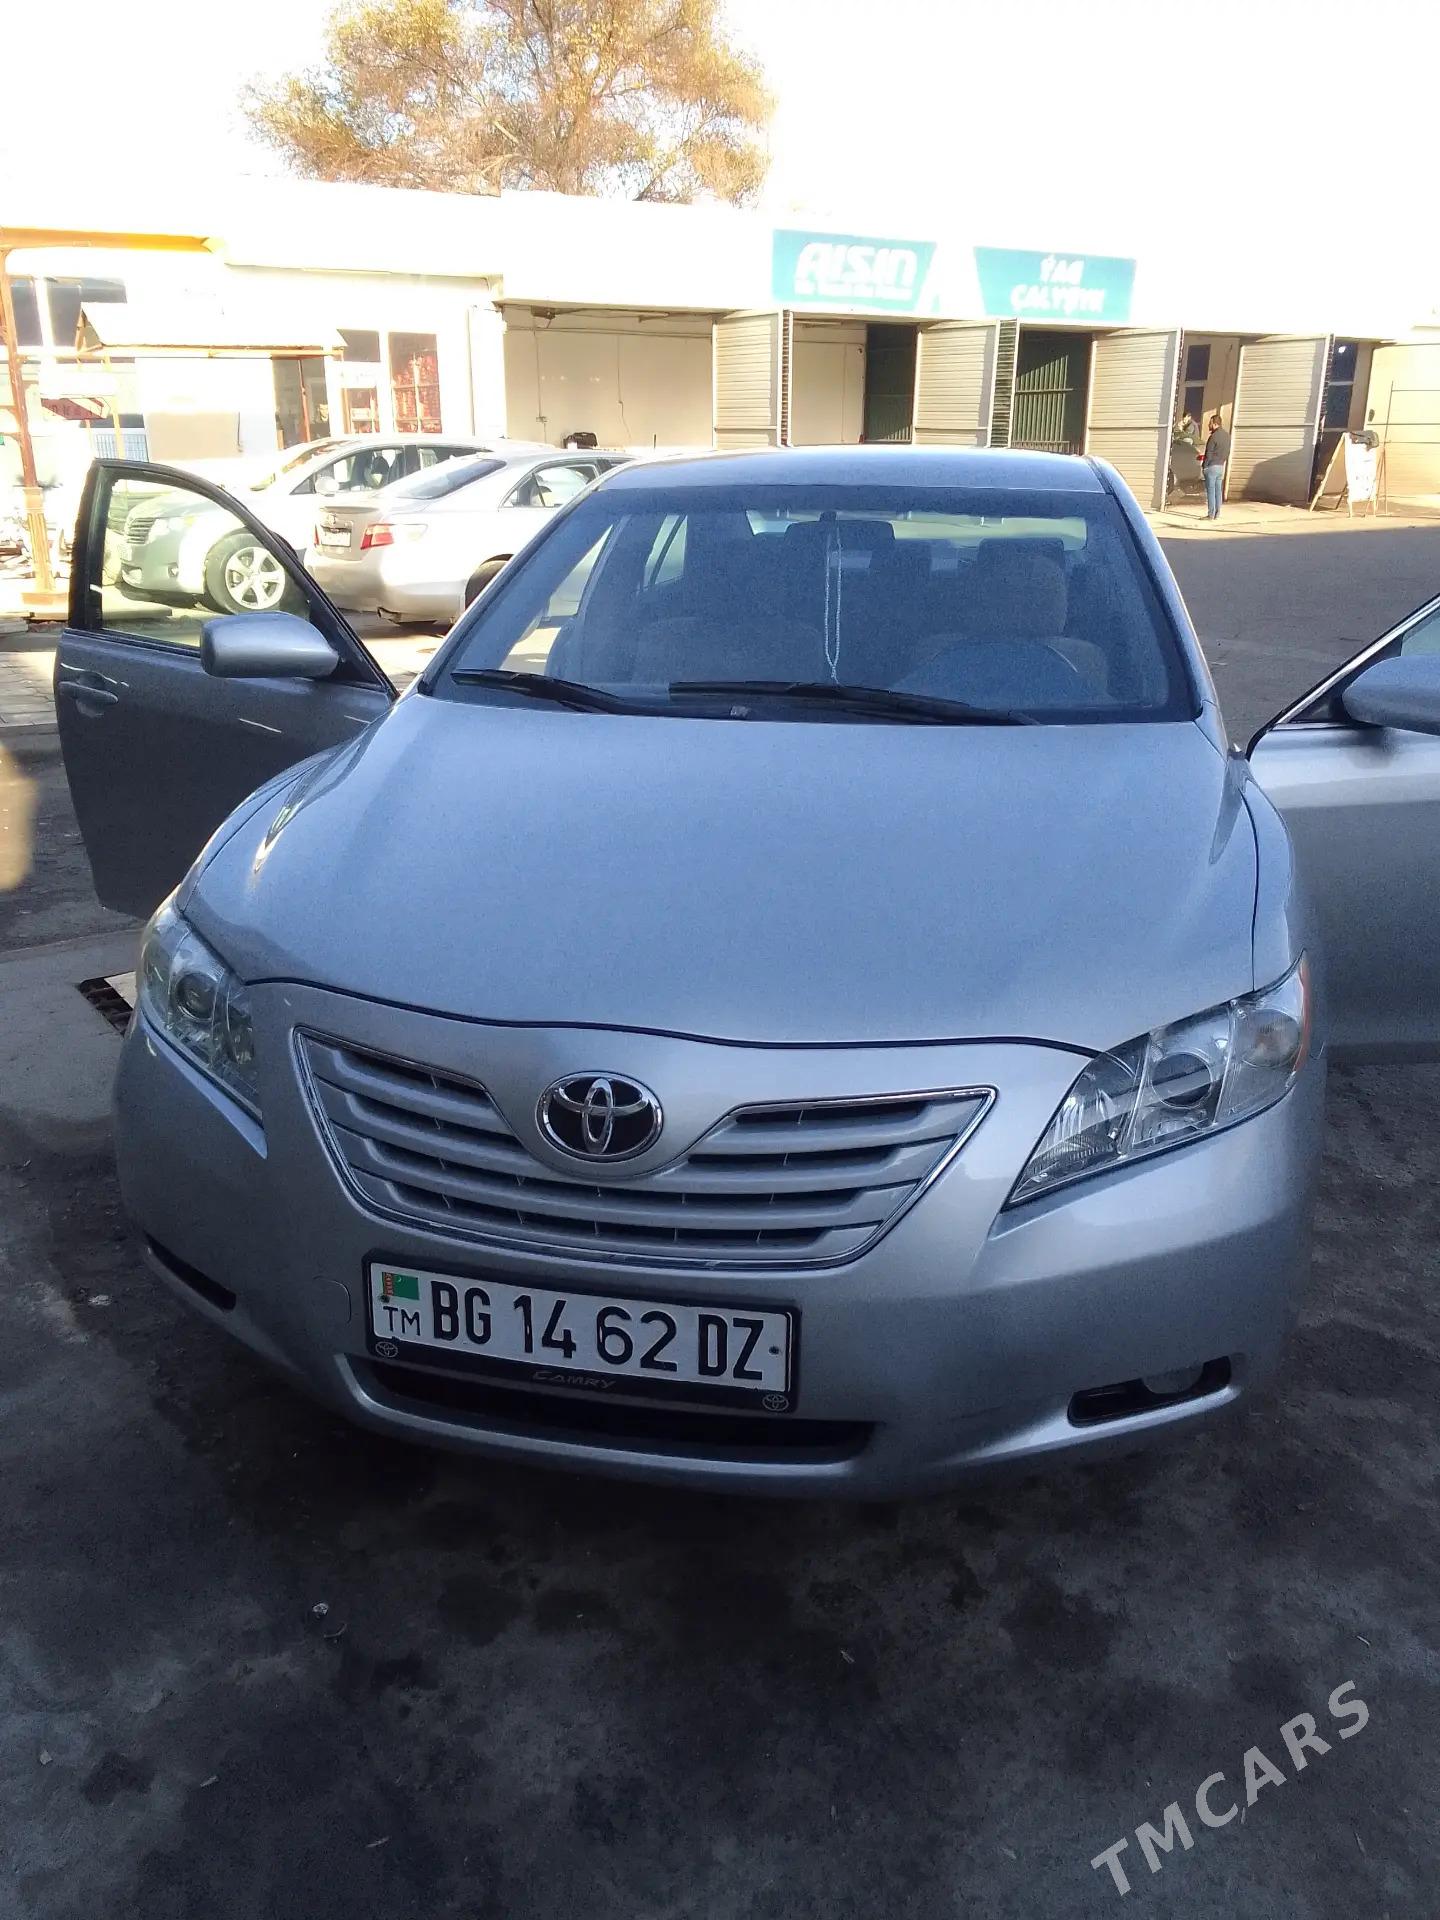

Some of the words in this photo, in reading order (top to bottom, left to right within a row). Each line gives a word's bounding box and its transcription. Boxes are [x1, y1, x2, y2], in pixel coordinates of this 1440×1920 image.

[796, 242, 917, 288] AISIN
[383, 1305, 421, 1336] TM
[430, 1280, 491, 1345] BG
[513, 1295, 577, 1359] 14
[596, 1306, 678, 1372] 62
[698, 1313, 765, 1381] DZ
[532, 1370, 616, 1389] CAMRY
